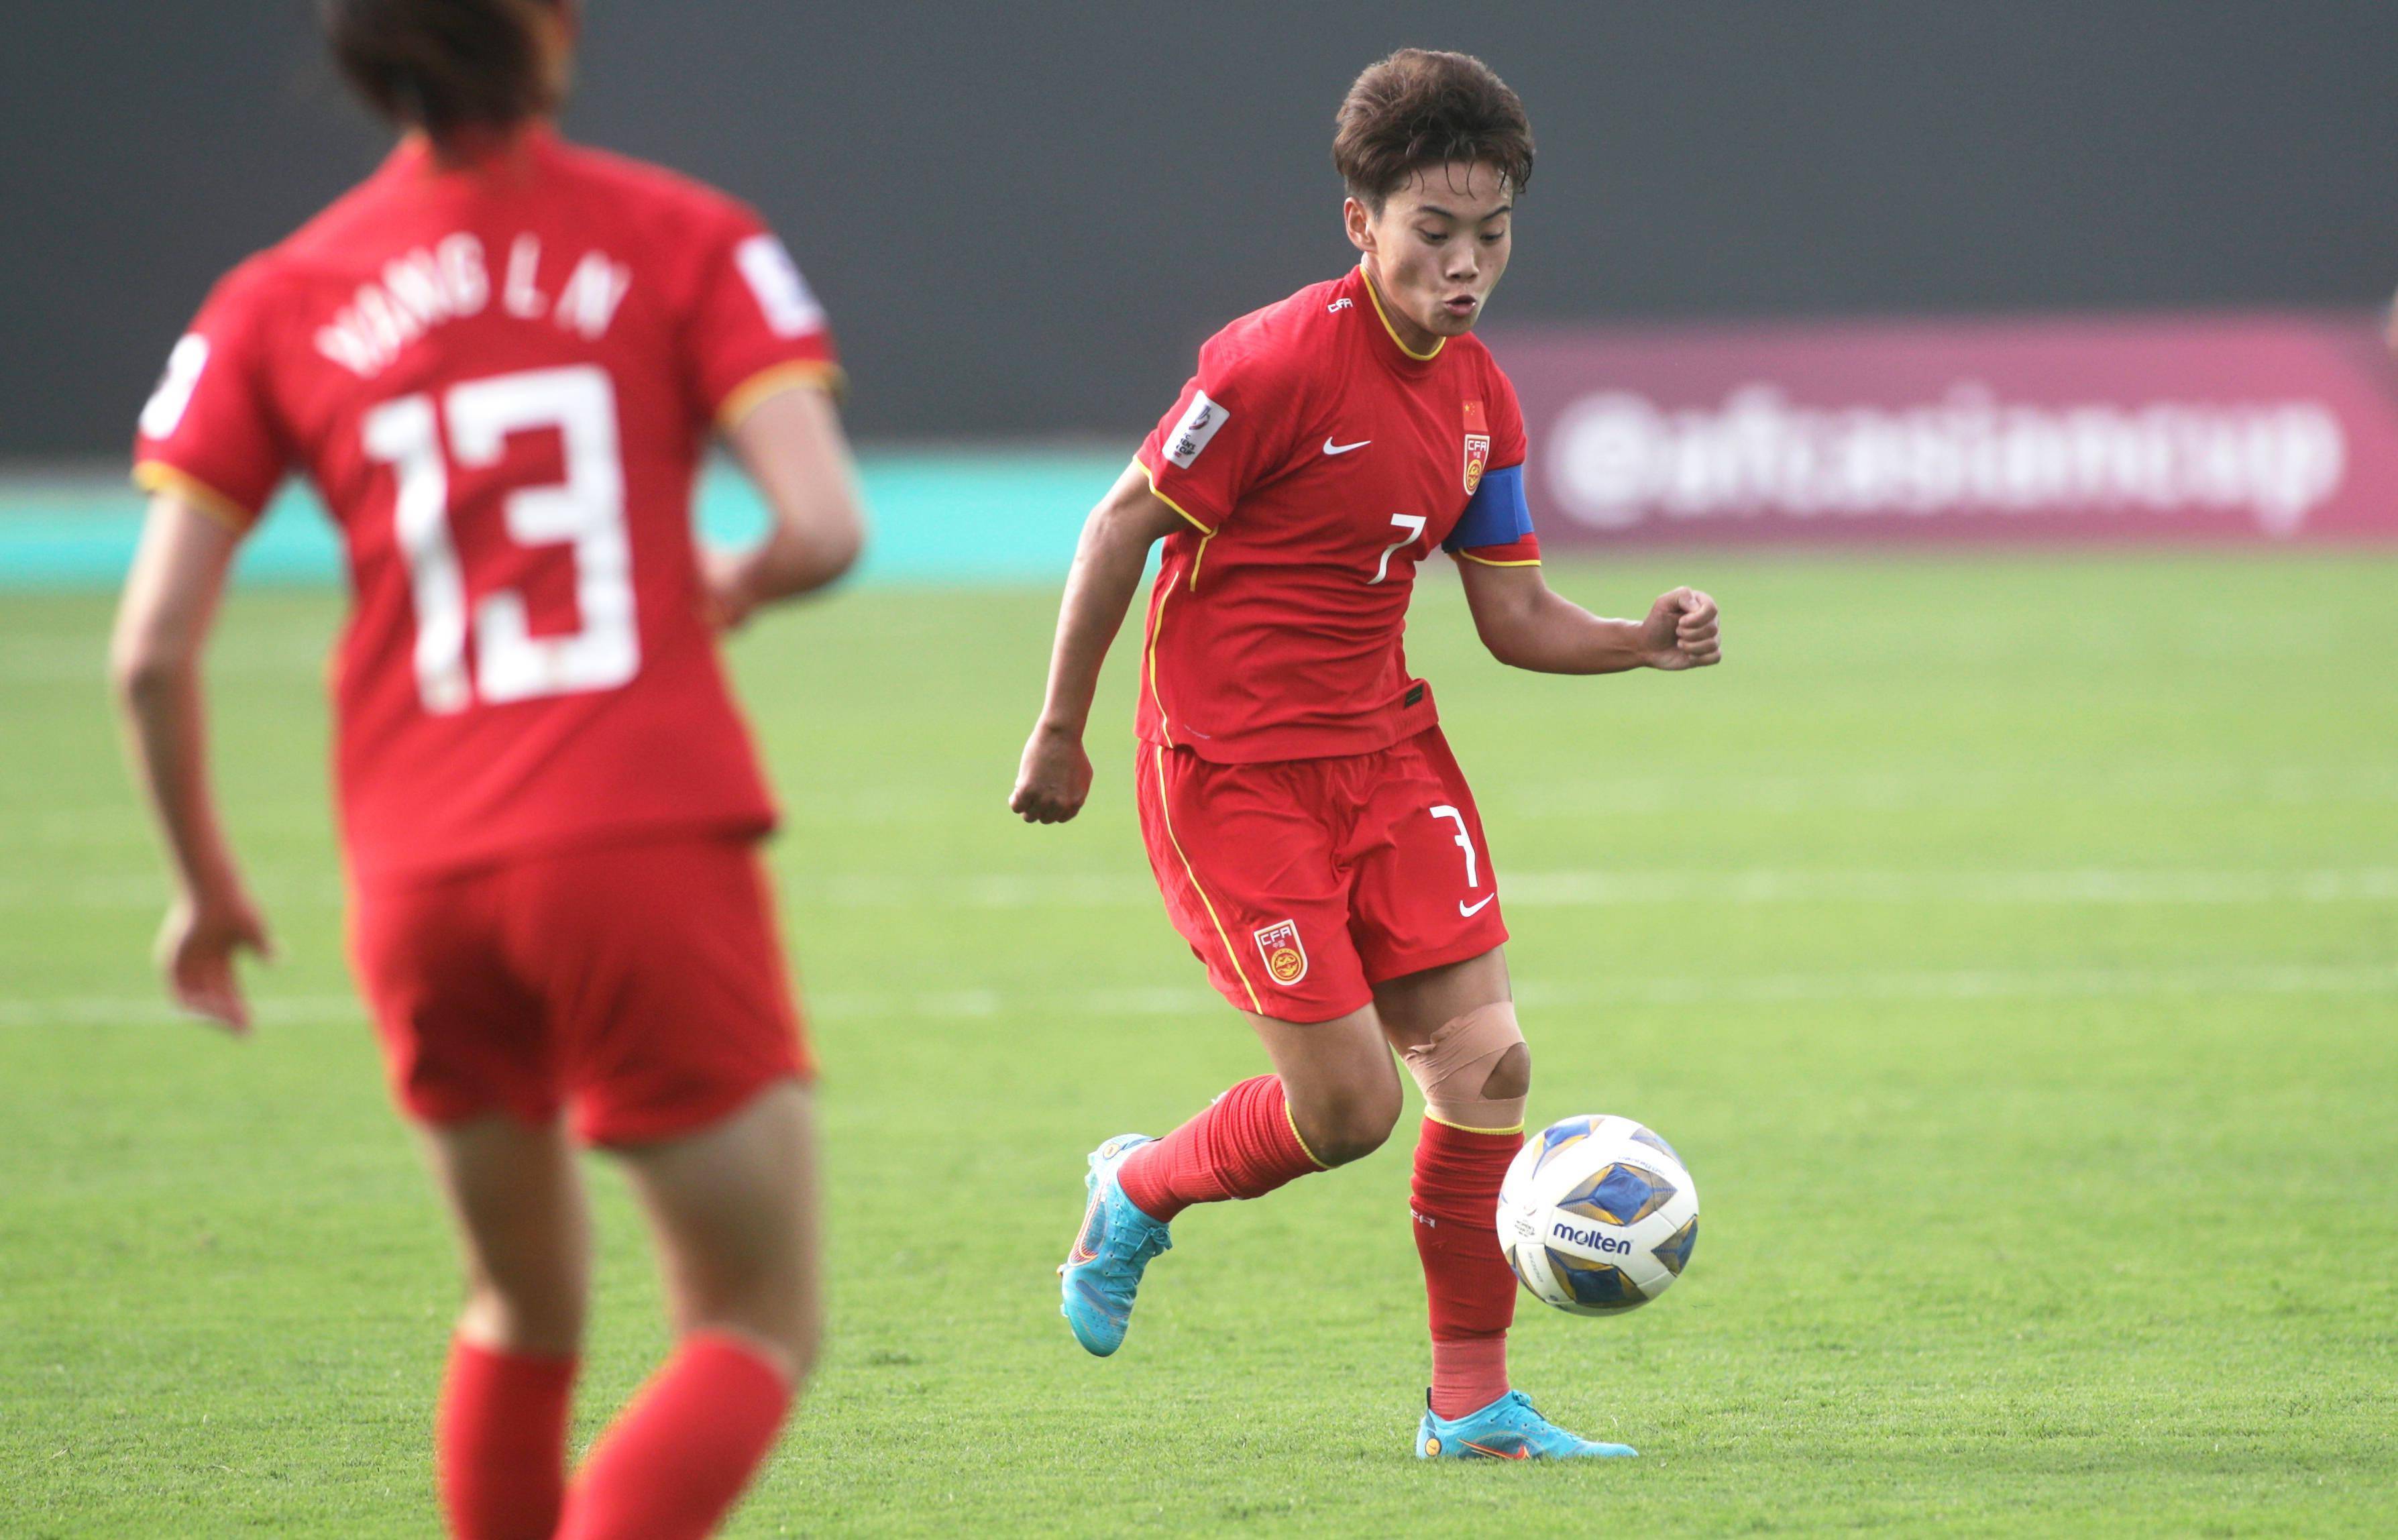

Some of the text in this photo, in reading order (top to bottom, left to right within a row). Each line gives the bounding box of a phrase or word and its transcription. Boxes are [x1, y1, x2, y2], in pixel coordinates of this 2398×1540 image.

[1327, 298, 1354, 313] CFA
[1468, 440, 1487, 451] CFA
[362, 366, 638, 714] 13
[1367, 513, 1427, 585] 7
[1429, 805, 1478, 887] 7
[1260, 926, 1292, 946] CFA
[1553, 1223, 1631, 1255] molten
